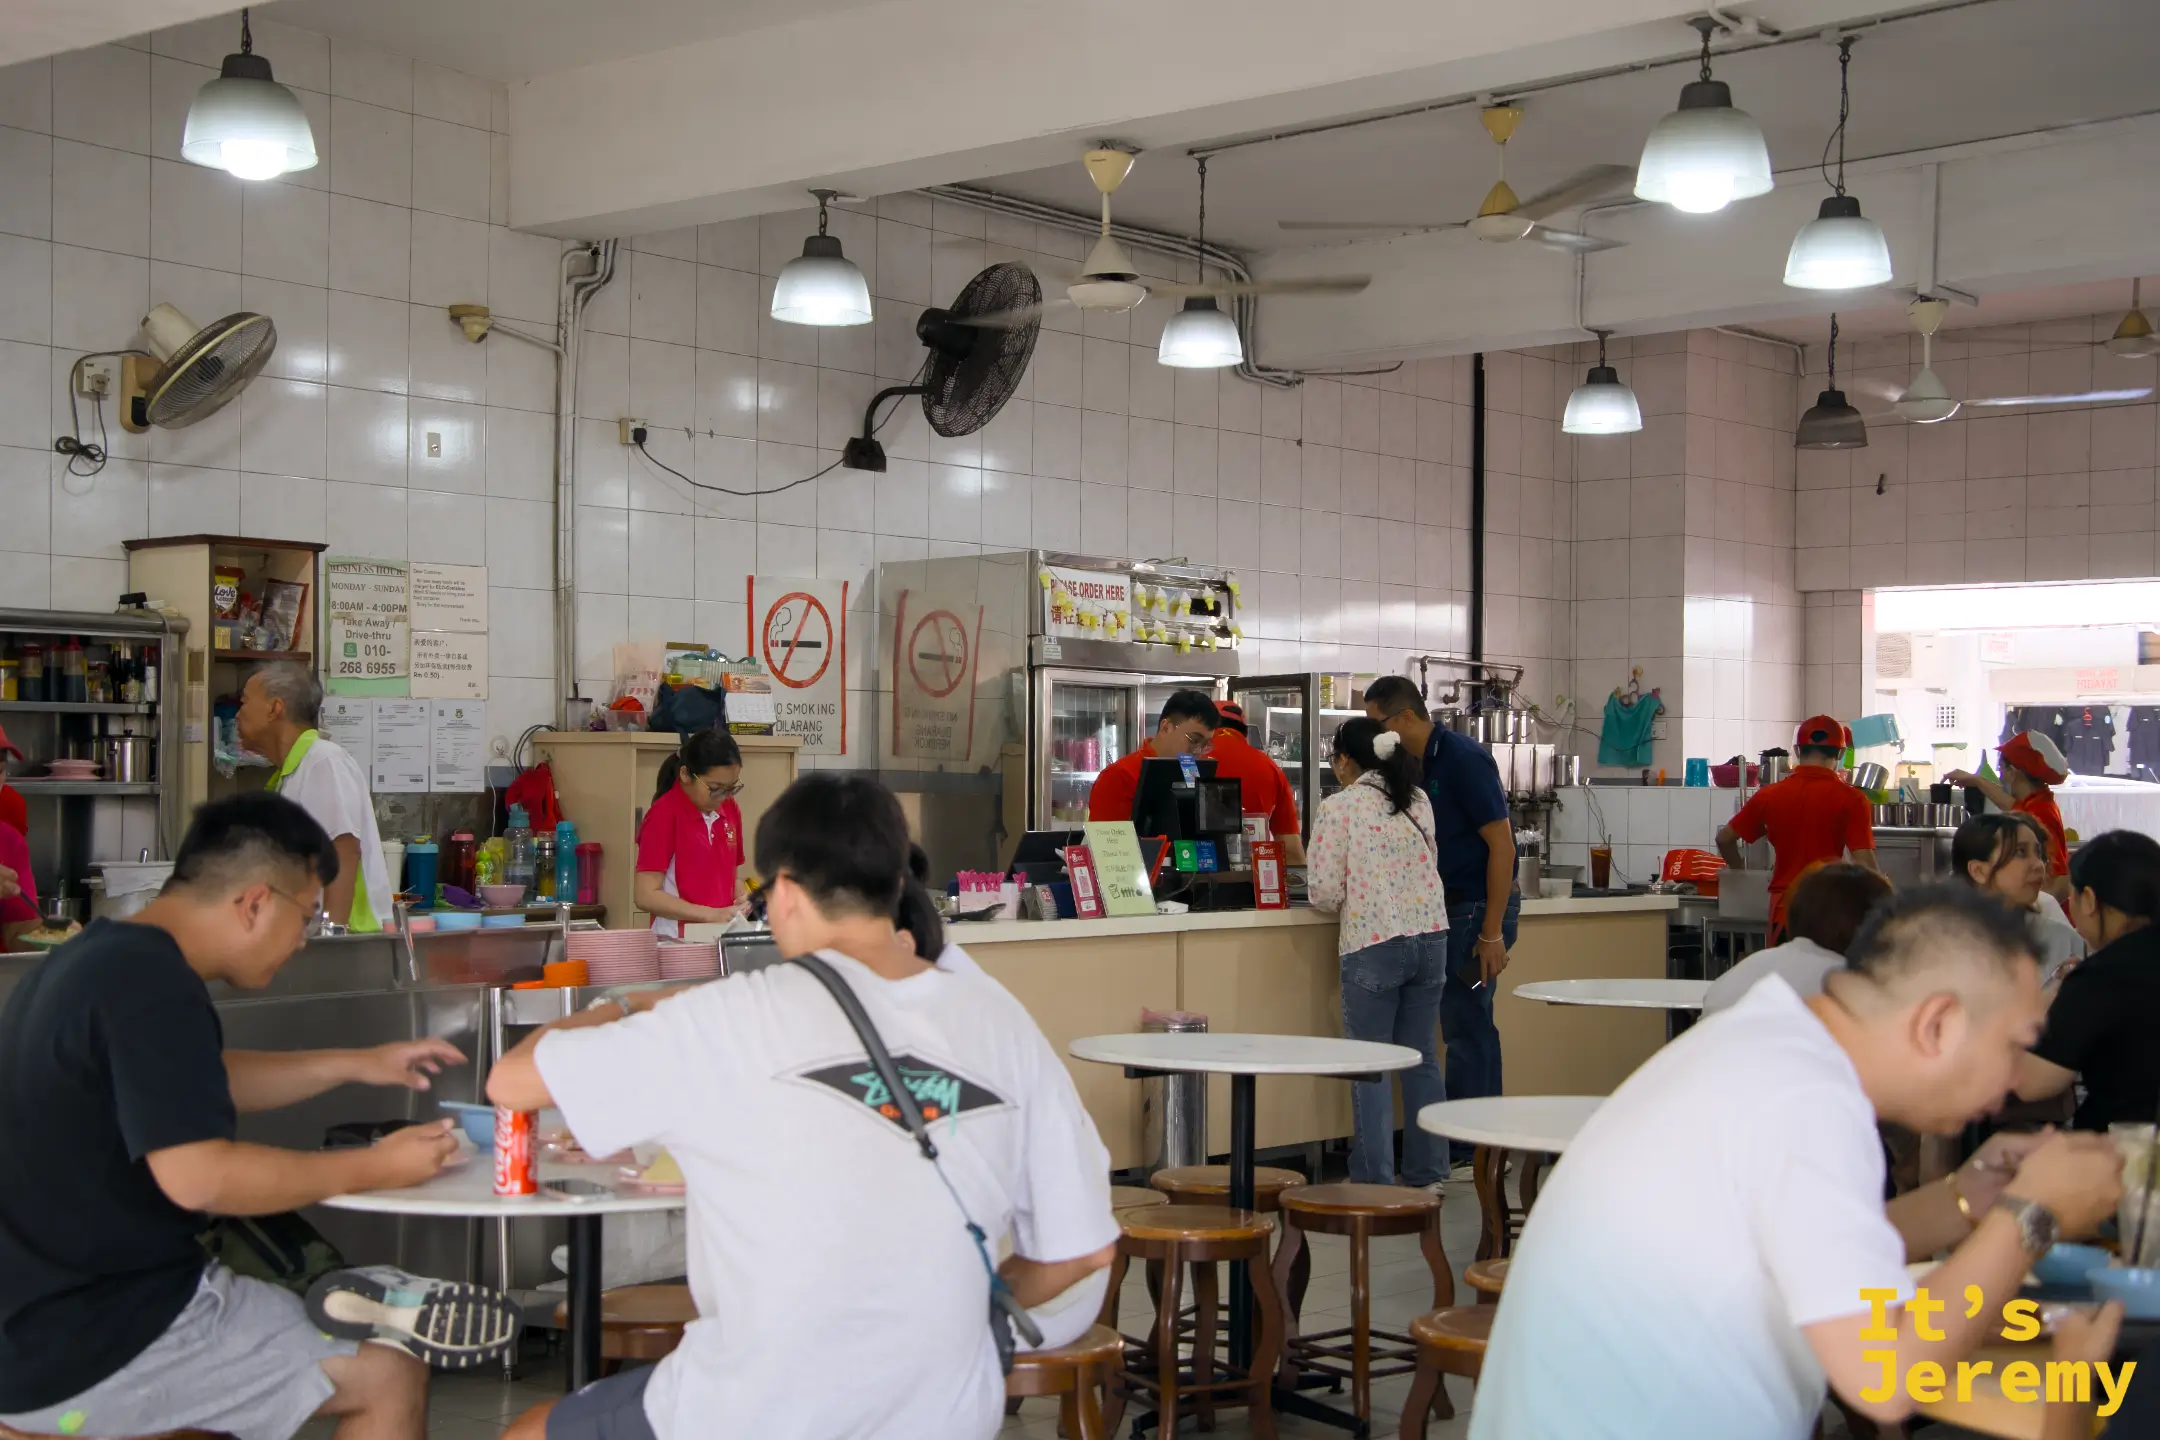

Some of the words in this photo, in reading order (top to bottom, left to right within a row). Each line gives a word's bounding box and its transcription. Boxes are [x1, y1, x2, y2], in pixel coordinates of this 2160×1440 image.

[330, 564, 374, 573] BUSINESS
[215, 586, 236, 597] Love
[331, 582, 366, 591] MONDAY
[373, 584, 405, 593] SUNDAY
[1079, 582, 1104, 599] ORDER
[1105, 584, 1125, 601] HERE
[331, 600, 364, 611] 8:00AM
[372, 603, 407, 613] 4:00PM
[343, 618, 362, 626] Take
[365, 618, 390, 629] Away
[345, 629, 391, 640] Drive-thru
[364, 644, 391, 656] 010-
[340, 661, 362, 673] 268
[366, 662, 396, 674] 6955
[774, 702, 783, 715] O
[786, 702, 835, 716] SMOKING
[776, 720, 823, 732] DILARANG
